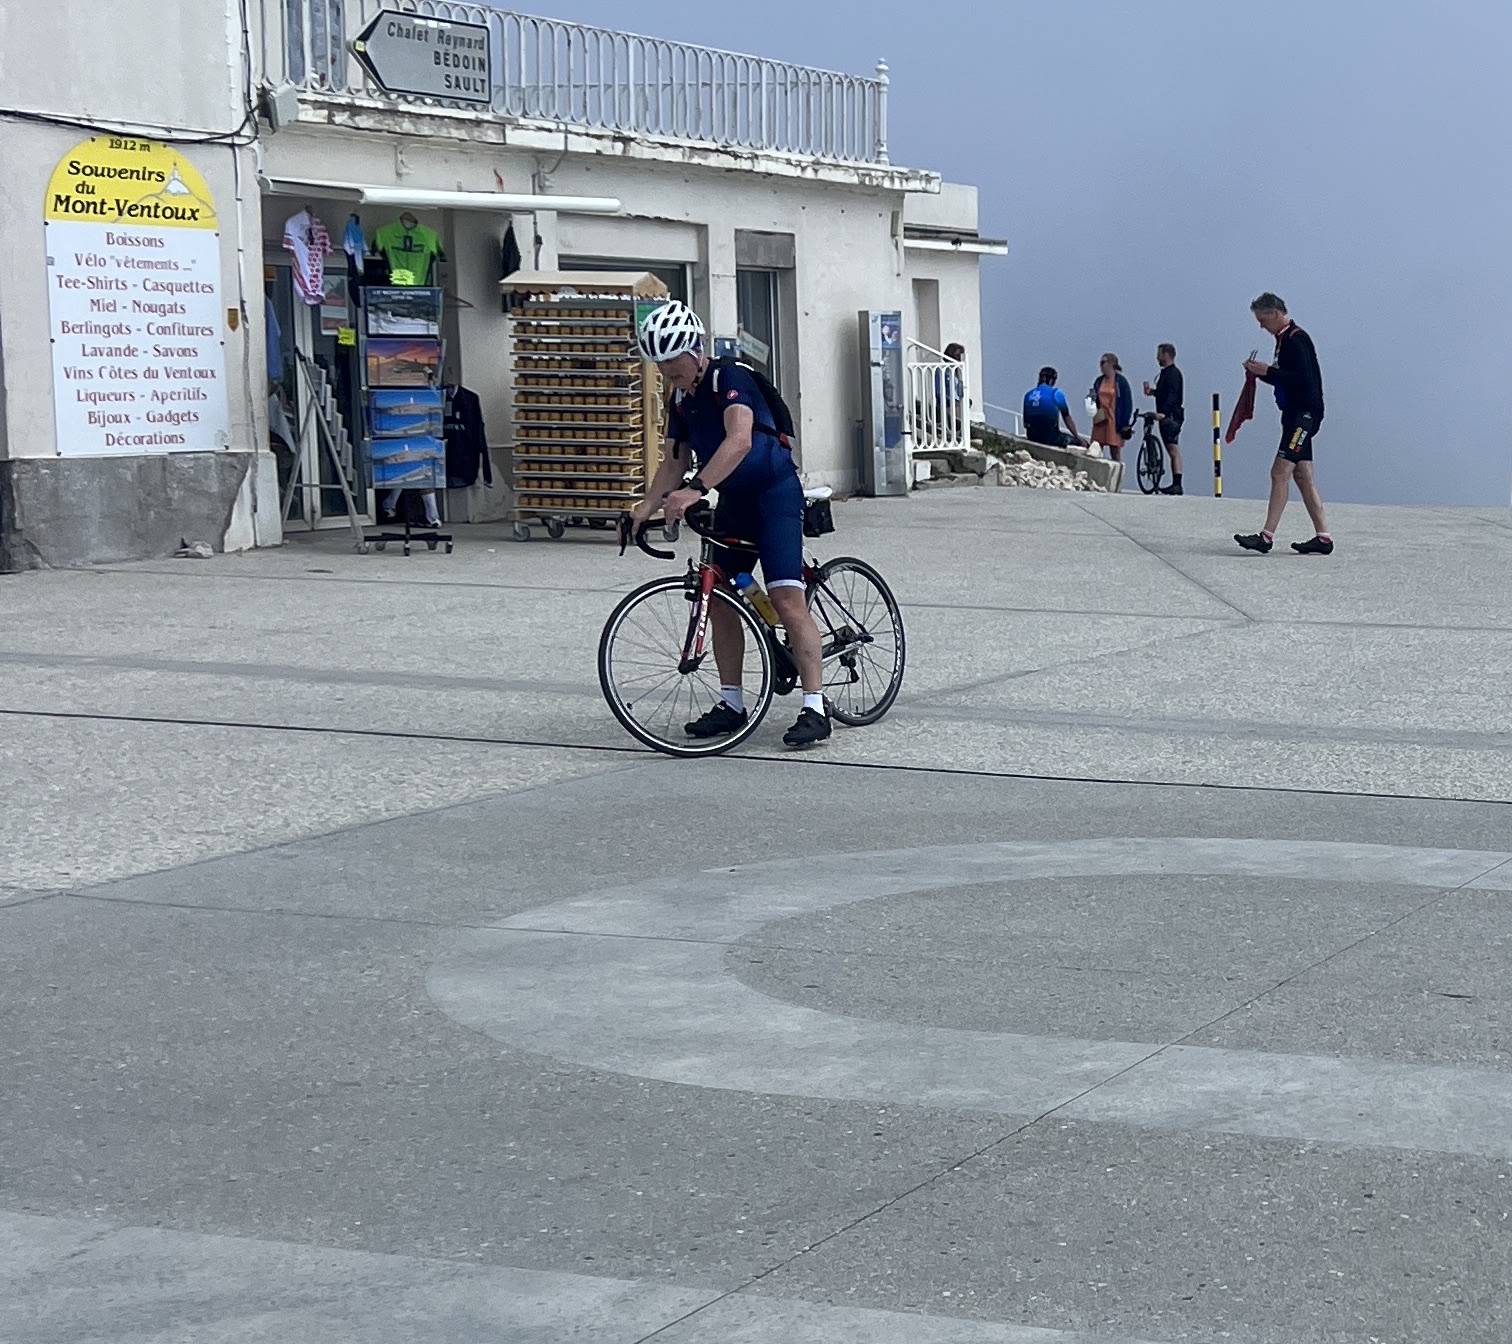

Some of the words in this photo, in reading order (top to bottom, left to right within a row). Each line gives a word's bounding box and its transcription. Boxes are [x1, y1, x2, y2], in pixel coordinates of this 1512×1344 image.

[387, 21, 429, 43] Chalet
[437, 29, 486, 51] Reynard
[434, 48, 486, 73] BÉDOIN
[444, 73, 487, 94] SAULT
[109, 138, 137, 151] 1912
[139, 143, 151, 153] m
[67, 160, 166, 183] Souvenirs
[75, 180, 96, 195] du
[53, 194, 200, 222] Mont-Ventoux
[105, 232, 165, 248] Boissons
[74, 252, 107, 268] Vélo
[56, 274, 129, 291] Tee-Shirts
[142, 277, 215, 296] Casquettes
[90, 298, 117, 313] Miel
[132, 299, 187, 318] Nougats
[60, 320, 132, 338] Berlingots
[146, 321, 215, 337] Confitures
[81, 343, 139, 358] Lavande
[152, 343, 199, 358] Savons
[63, 365, 94, 380] Vins
[98, 365, 139, 380] Côtes
[143, 366, 159, 380] du
[163, 366, 217, 380] Ventoux
[76, 388, 136, 406] Liqueurs
[87, 410, 131, 428] Bijoux
[146, 410, 200, 425] Gadgets
[105, 431, 186, 447] Décorations
